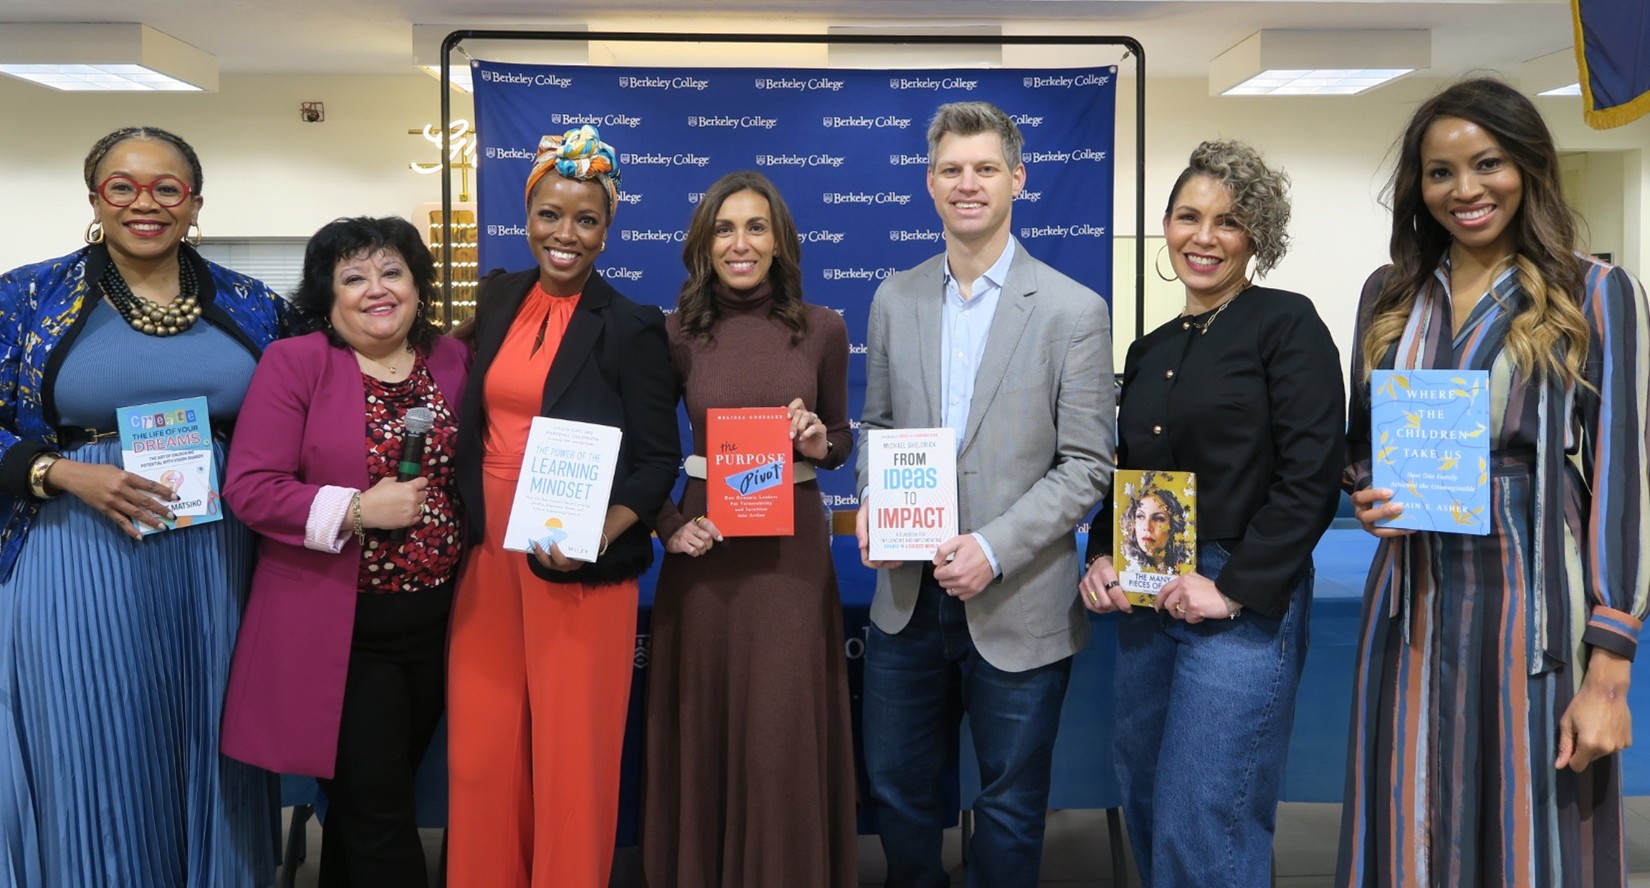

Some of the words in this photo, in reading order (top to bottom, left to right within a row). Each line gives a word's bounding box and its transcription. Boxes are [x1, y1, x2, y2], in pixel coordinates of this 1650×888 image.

[492, 72, 534, 87] Berkeley
[535, 74, 572, 87] College
[630, 77, 672, 90] Berkeley
[673, 77, 708, 90] College
[766, 79, 807, 91] Berkeley
[808, 79, 844, 91] College
[900, 78, 941, 90] Berkeley
[942, 78, 978, 90] College
[1034, 75, 1074, 88] Berkeley
[1075, 75, 1109, 87] College
[562, 114, 604, 126] Berkeley
[605, 114, 641, 127] College
[698, 116, 739, 128] Berkeley
[741, 116, 777, 129] College
[834, 117, 874, 129] Berkeley
[875, 116, 911, 129] College
[497, 148, 536, 161] Berkeley
[631, 154, 672, 166] Berkeley
[673, 154, 709, 167] College
[766, 154, 807, 167] Berkeley
[809, 154, 844, 167] College
[900, 154, 930, 165] Berkel
[1033, 151, 1071, 165] Berkeley
[1072, 150, 1105, 163] College
[616, 191, 641, 204] ollege
[834, 192, 874, 205] Berkeley
[876, 192, 911, 205] College
[498, 225, 530, 236] Berkel
[632, 230, 672, 243] Berkeley
[809, 230, 844, 243] College
[900, 230, 941, 242] Berkeley
[1031, 226, 1068, 240] Berkeley
[1070, 225, 1104, 238] College
[606, 267, 642, 280] College
[834, 268, 874, 281] Berkeley
[876, 268, 898, 279] Coll
[1406, 390, 1456, 399] WHERE
[1418, 410, 1445, 419] THE
[177, 425, 199, 433] YOUR
[1396, 429, 1468, 440] CHILDREN
[133, 433, 201, 454] DREAMS
[720, 441, 738, 453] the
[536, 446, 548, 455] THE
[551, 447, 575, 459] POWER
[577, 451, 587, 460] OF
[589, 453, 601, 463] THE
[715, 453, 786, 465] PURPOSE
[893, 452, 927, 466] FROM
[1404, 449, 1437, 459] TAKE
[1444, 450, 1462, 459] US
[531, 457, 599, 481] LEARNING
[529, 476, 593, 501] MINDSET
[904, 491, 917, 505] TO
[171, 499, 202, 511] MATSIKO
[1437, 504, 1468, 513] ASHER
[877, 507, 945, 529] IMPACT
[1135, 573, 1148, 581] THE
[1128, 580, 1150, 588] PIECES
